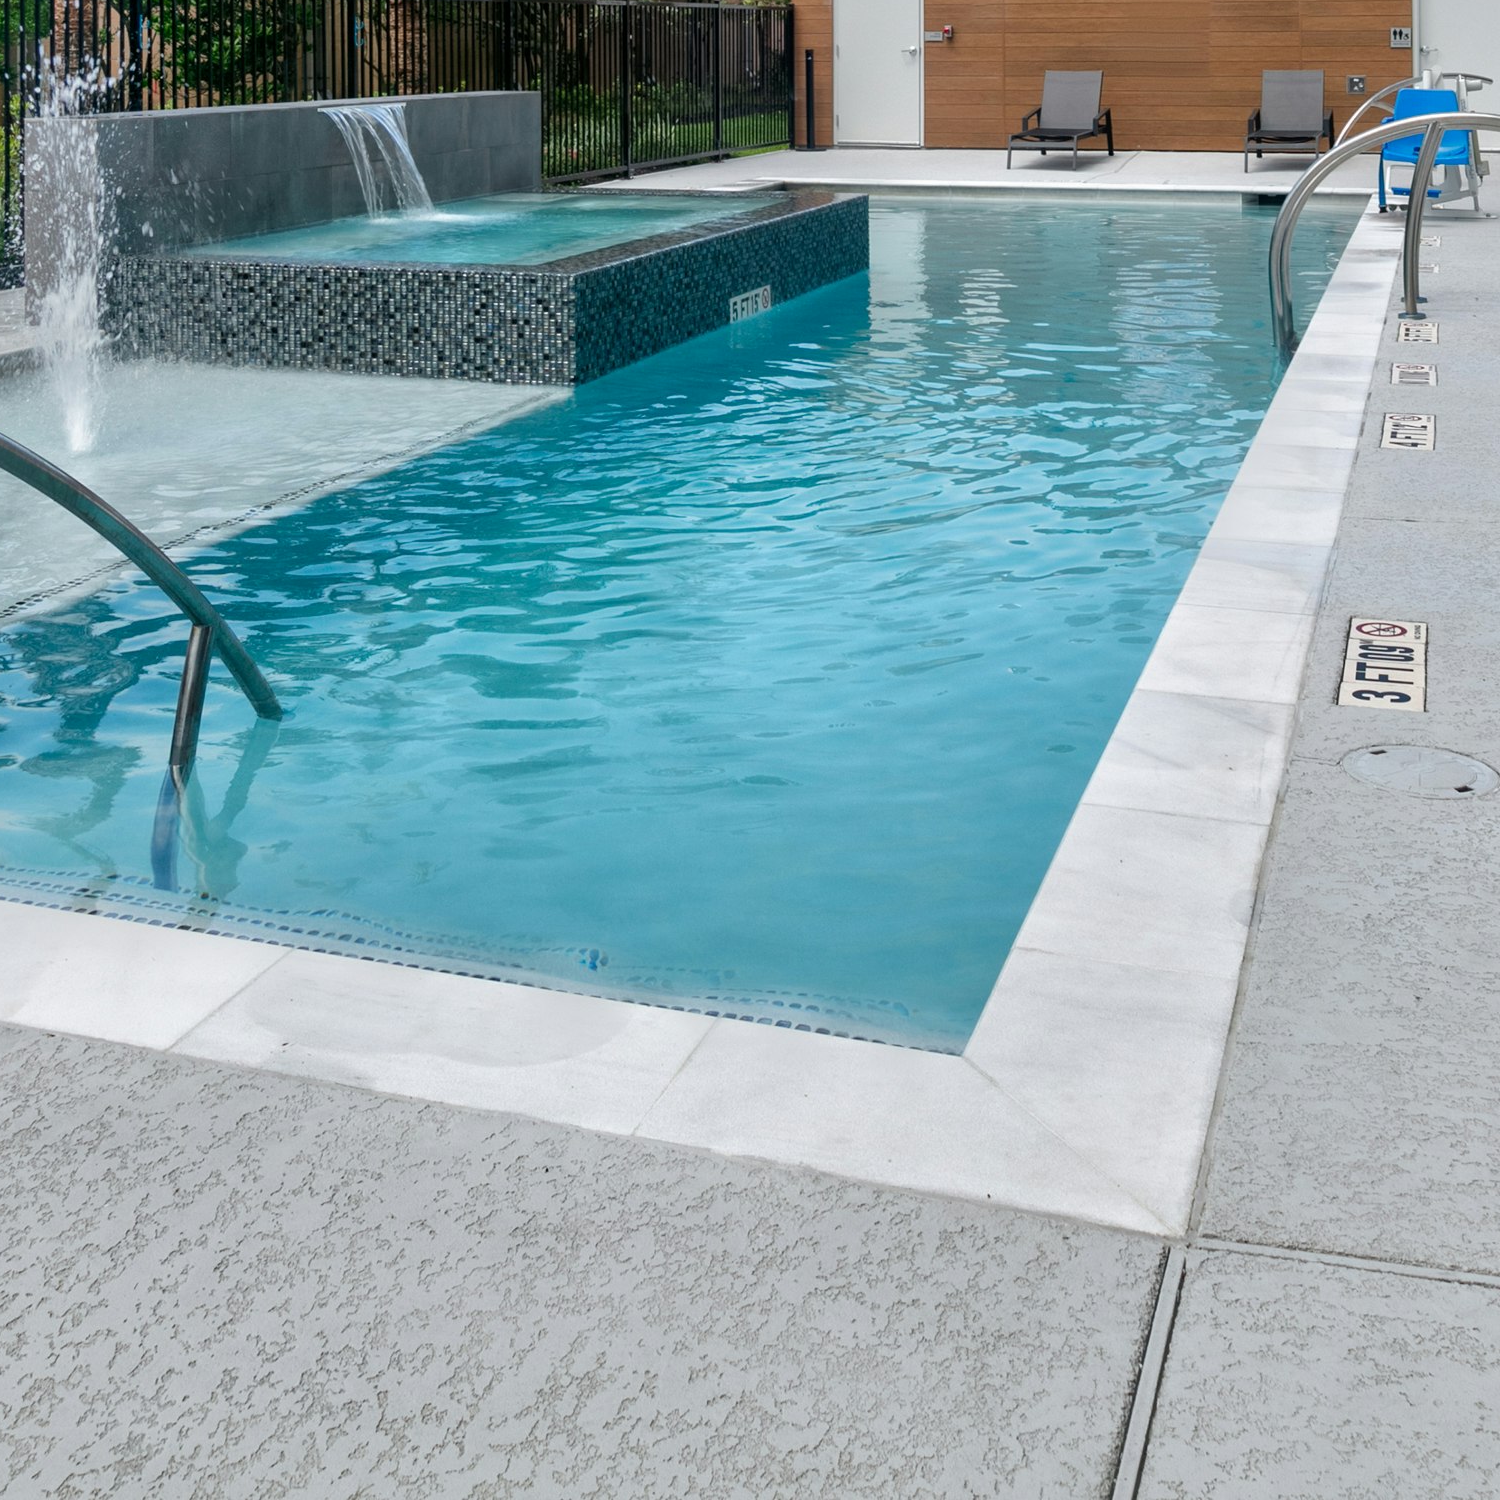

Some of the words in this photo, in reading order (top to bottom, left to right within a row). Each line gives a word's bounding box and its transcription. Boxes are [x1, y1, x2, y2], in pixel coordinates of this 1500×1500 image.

[732, 301, 739, 322] 5
[740, 296, 750, 319] FT
[1390, 431, 1428, 441] FT
[1355, 661, 1414, 685] FT
[1351, 689, 1412, 704] 3
